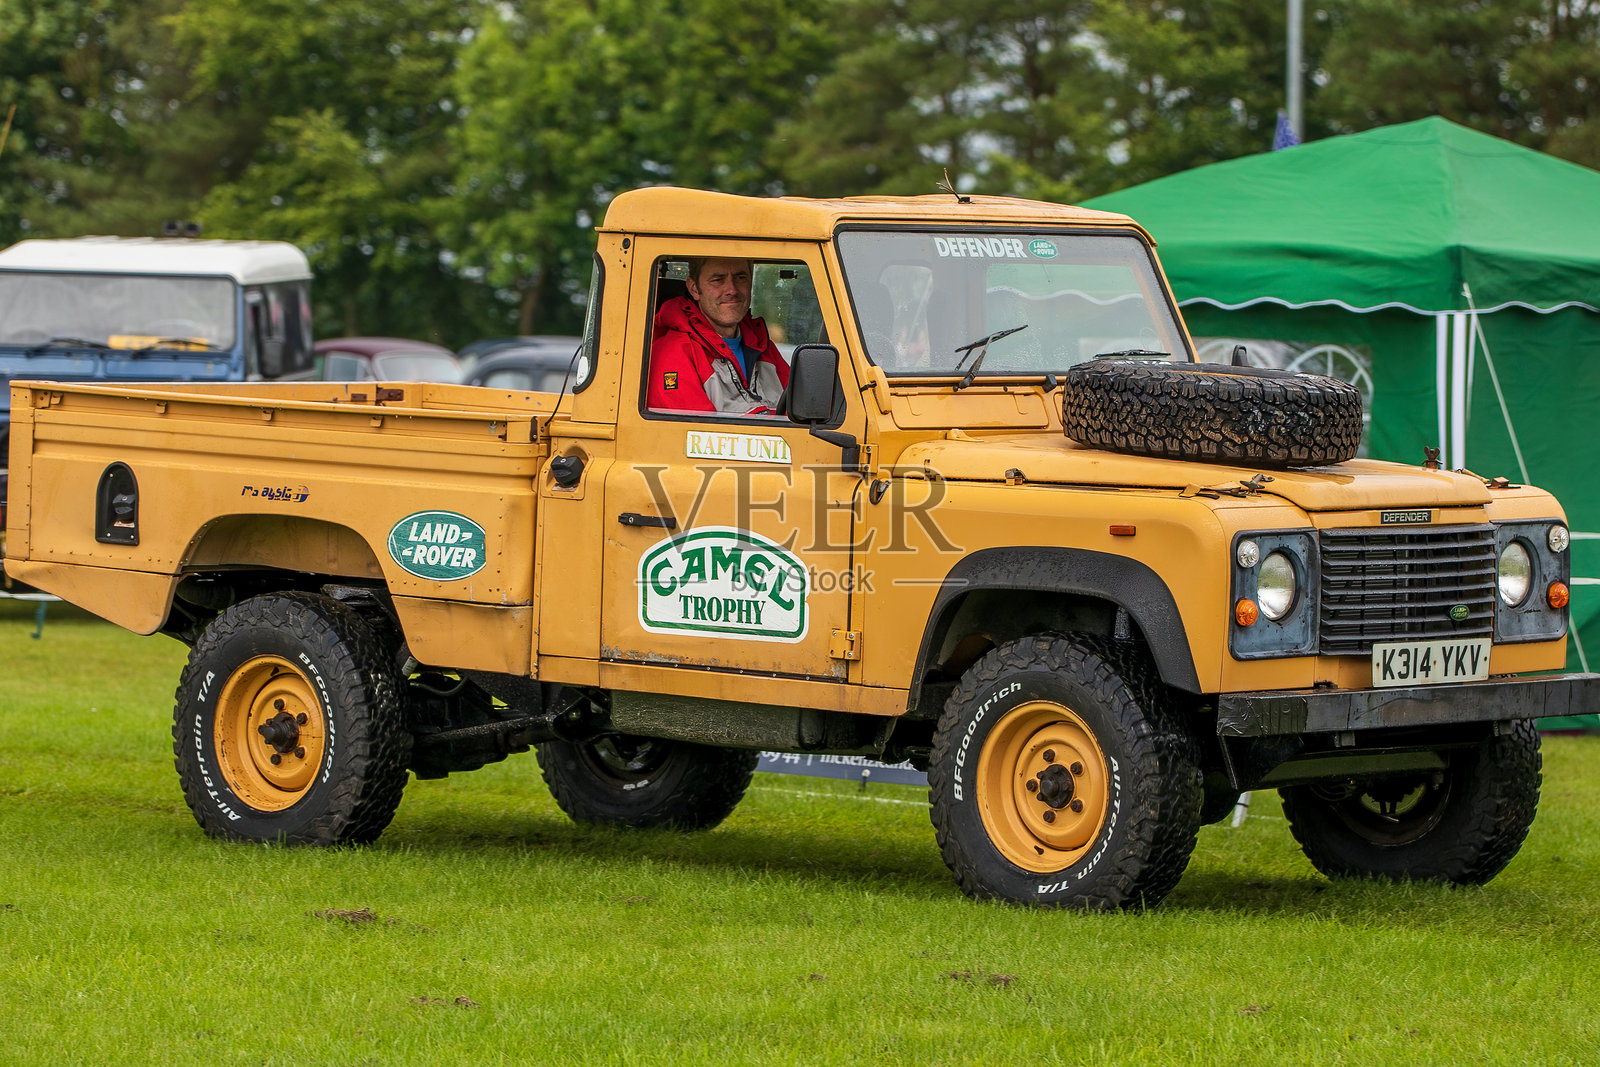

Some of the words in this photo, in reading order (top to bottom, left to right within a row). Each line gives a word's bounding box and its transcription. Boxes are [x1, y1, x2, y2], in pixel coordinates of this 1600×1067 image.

[934, 237, 1028, 258] DEFENDER
[690, 434, 739, 457] RAFT
[746, 438, 788, 460] UNIT
[408, 521, 461, 544] LAND
[1383, 511, 1429, 522] DEFENDER
[412, 544, 477, 568] ROVER
[650, 545, 795, 611] CAMEL
[679, 593, 767, 625] TROPHY
[1382, 647, 1431, 681] K314
[1442, 644, 1482, 677] YKV
[197, 670, 216, 703] T/A
[299, 652, 336, 784] BFGoodrich
[954, 681, 1022, 801] BFGoodrich
[193, 714, 242, 822] All-Terrain
[1077, 755, 1121, 880] All-Terrain
[1037, 880, 1069, 894] T/A
